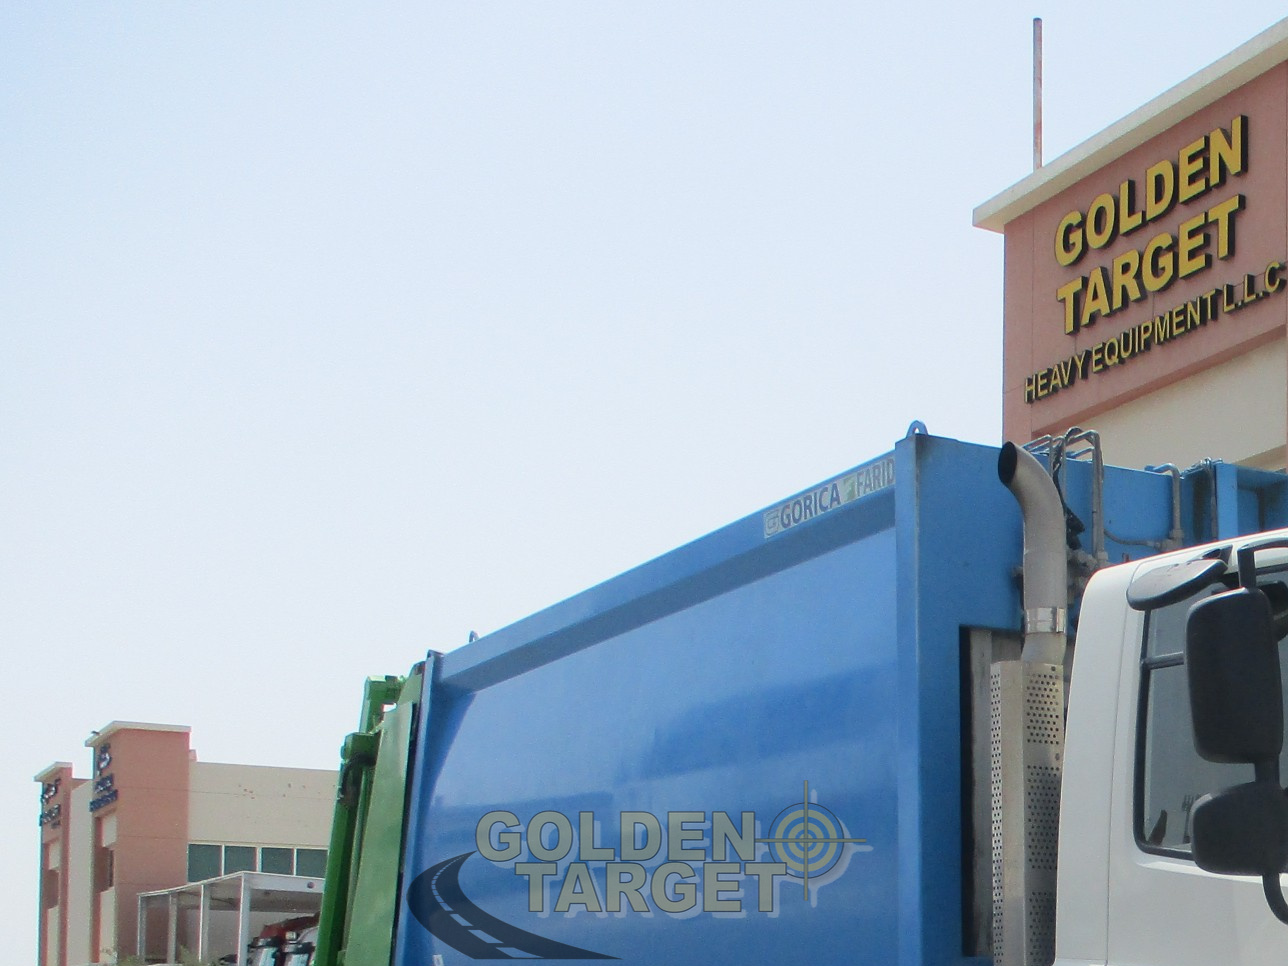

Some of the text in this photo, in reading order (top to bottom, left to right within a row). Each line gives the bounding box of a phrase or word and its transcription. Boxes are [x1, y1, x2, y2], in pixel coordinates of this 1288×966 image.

[1054, 115, 1248, 268] GOLDEN
[1024, 261, 1287, 403] HEAVY EQUIPMENT L.L.C
[1057, 193, 1245, 335] TARGET
[780, 458, 895, 529] GORICA FARID
